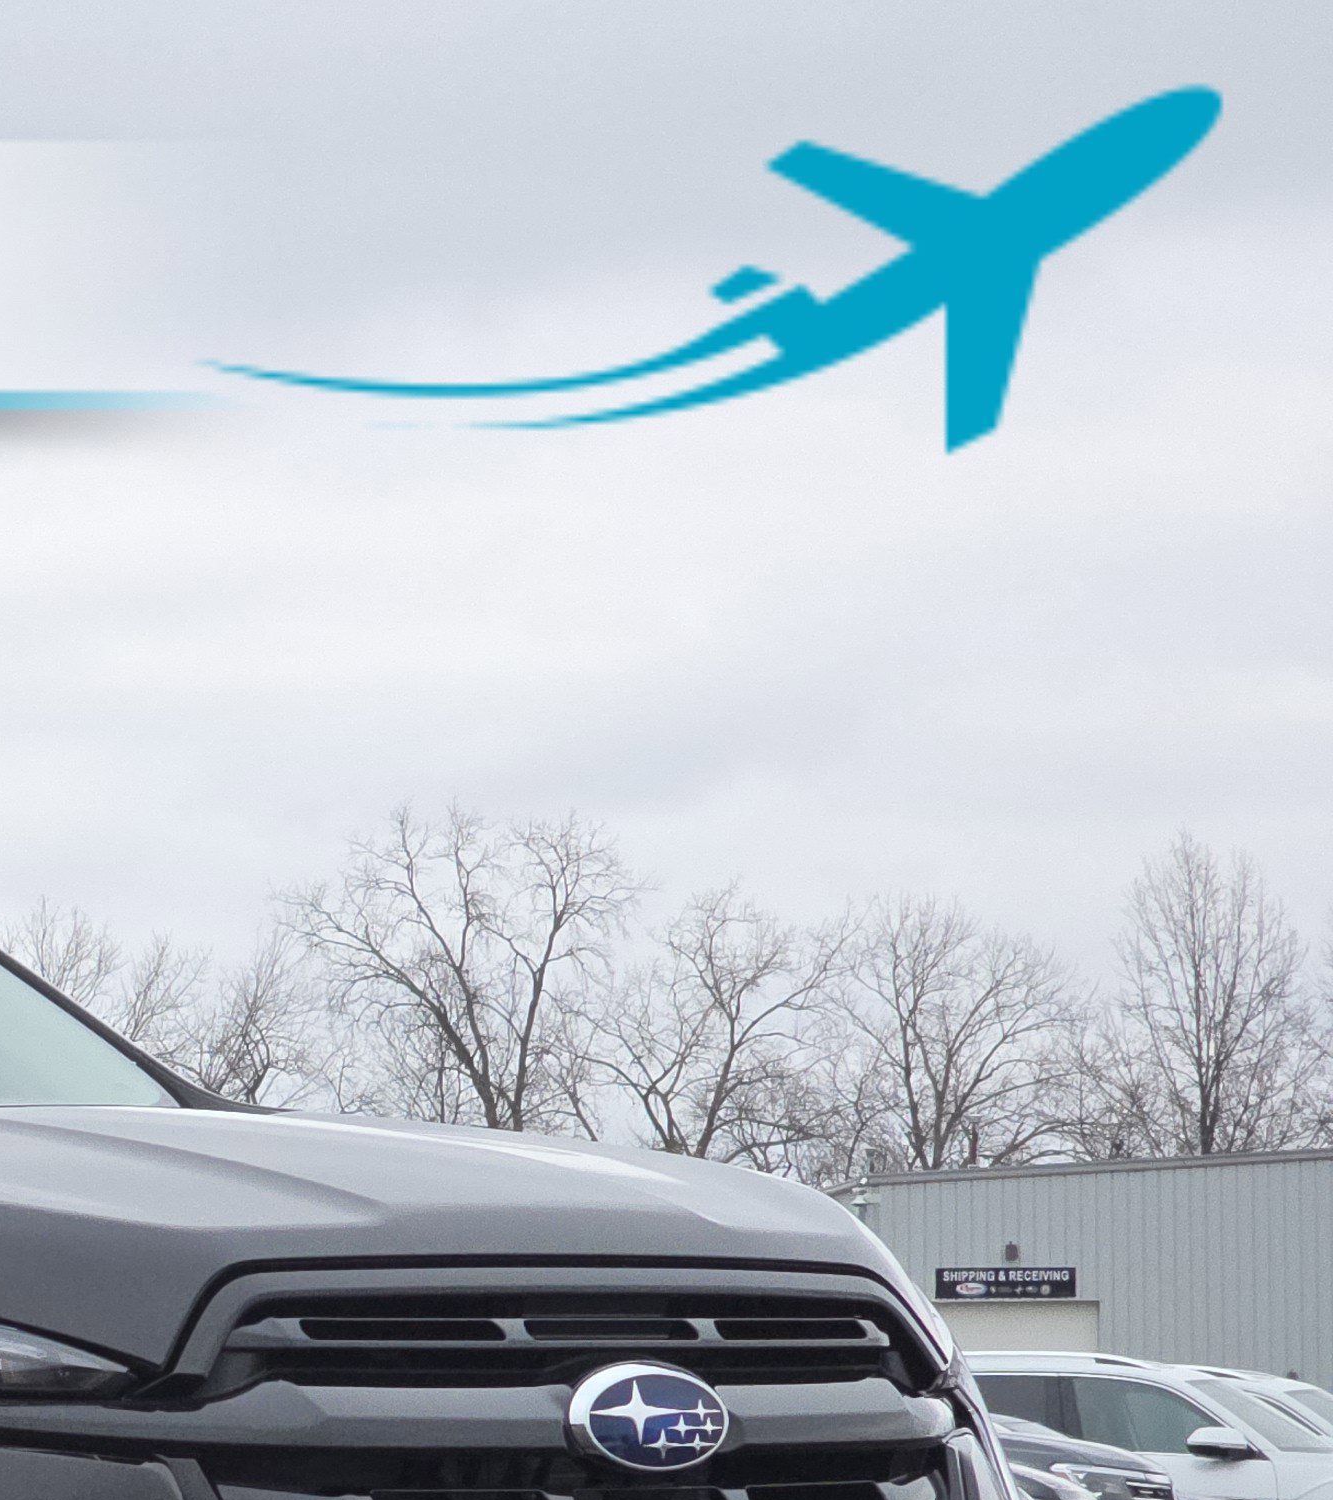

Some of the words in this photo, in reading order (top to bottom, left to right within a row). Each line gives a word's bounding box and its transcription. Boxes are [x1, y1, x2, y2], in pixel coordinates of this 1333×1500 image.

[943, 1270, 995, 1281] SHIPPING
[998, 1270, 1006, 1281] &
[1009, 1270, 1070, 1281] RECEIVING
